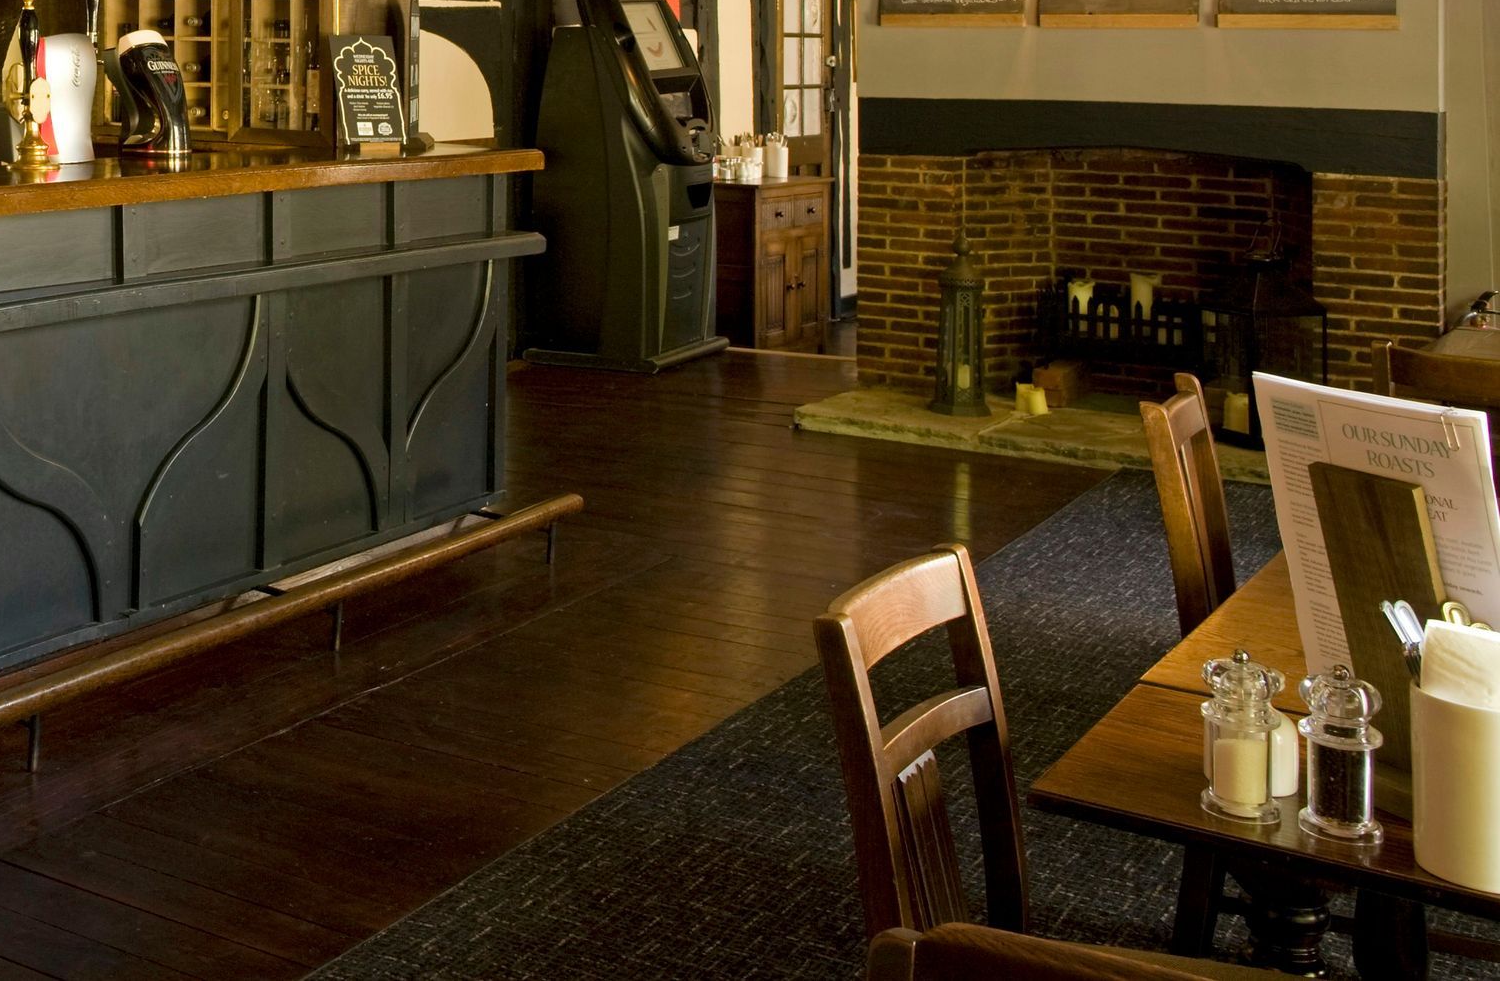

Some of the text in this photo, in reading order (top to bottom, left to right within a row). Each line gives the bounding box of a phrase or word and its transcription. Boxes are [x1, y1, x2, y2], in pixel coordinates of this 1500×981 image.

[352, 64, 380, 75] SPICE
[347, 75, 388, 87] NIGHTS!
[377, 92, 393, 100] £6.95
[1342, 423, 1452, 459] OUR SUNDAY
[1366, 449, 1436, 478] ROASTS
